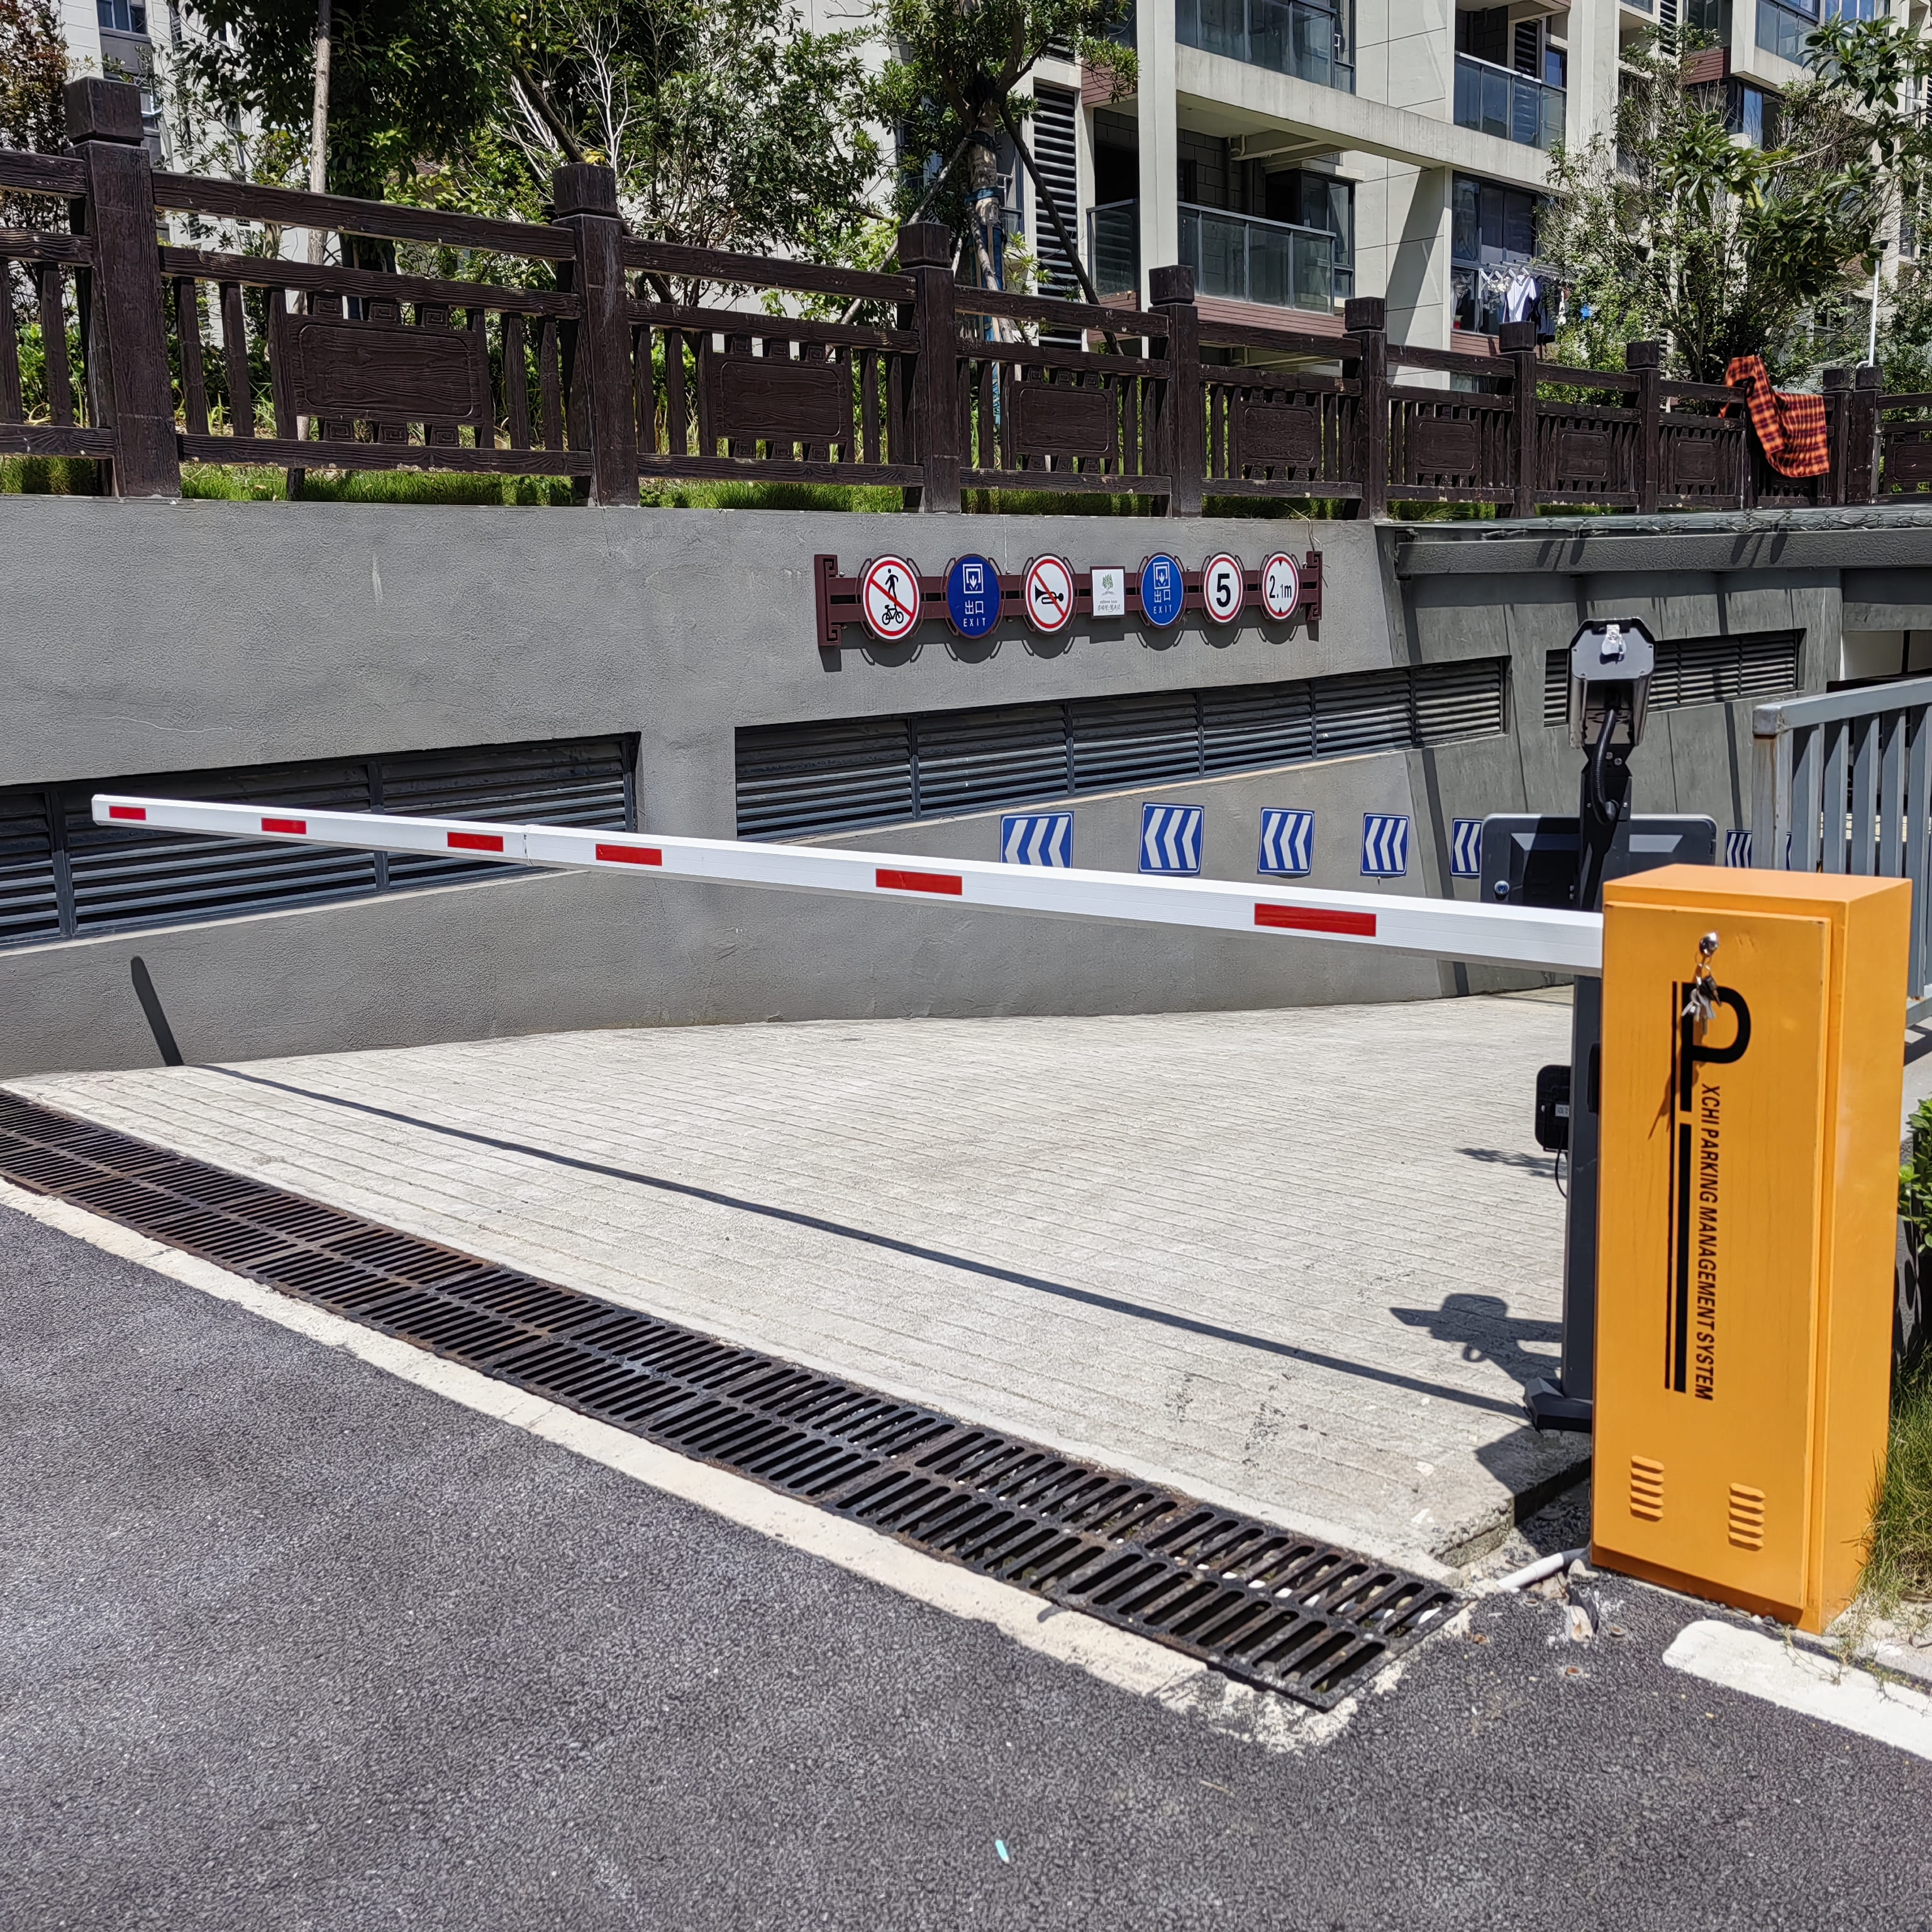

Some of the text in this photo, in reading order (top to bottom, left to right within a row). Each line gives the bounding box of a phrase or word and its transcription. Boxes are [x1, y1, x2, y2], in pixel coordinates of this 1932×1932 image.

[1154, 589, 1170, 602] 出口
[1216, 573, 1231, 608] 5
[1269, 575, 1292, 599] 2.1m
[965, 600, 984, 614] 出口
[1153, 604, 1172, 614] EXIT
[963, 618, 985, 627] EXIT
[1680, 982, 1752, 1113] P
[1694, 1083, 1721, 1401] XCHI PARKING MANAGEMENT SYSTEM
